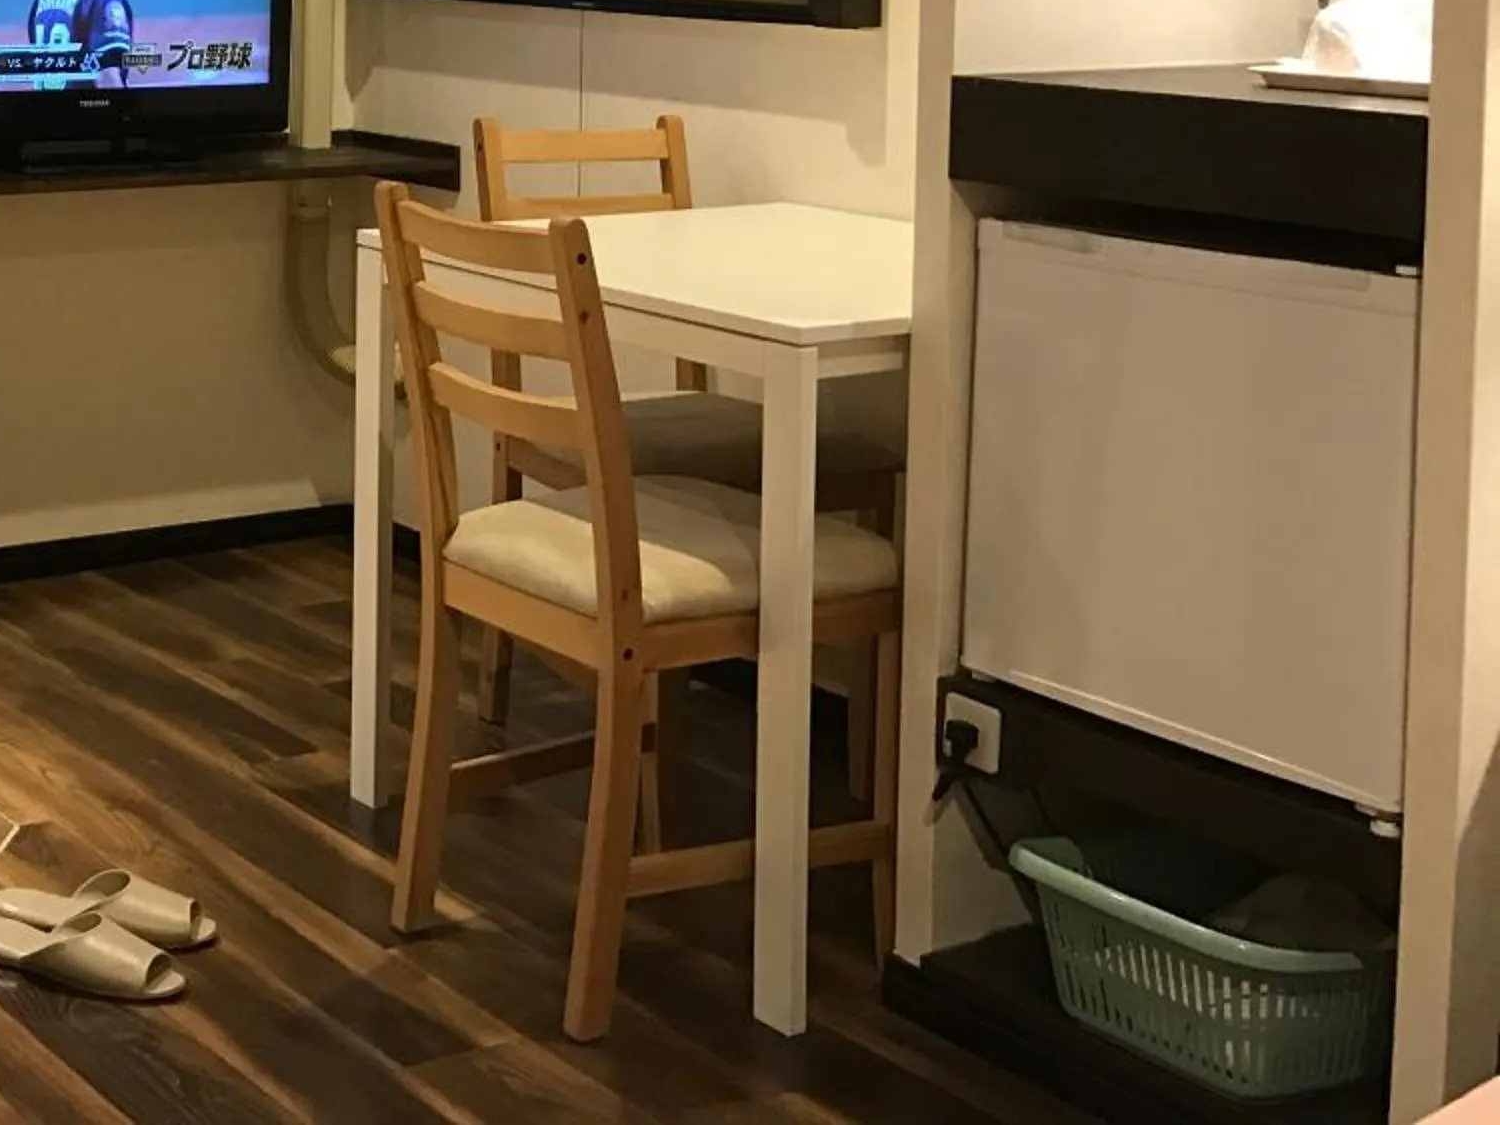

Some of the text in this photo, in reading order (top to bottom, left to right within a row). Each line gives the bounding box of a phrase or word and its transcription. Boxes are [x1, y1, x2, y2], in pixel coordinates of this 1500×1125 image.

[33, 56, 77, 68] ヤクルト
[166, 39, 253, 71] プロ野球
